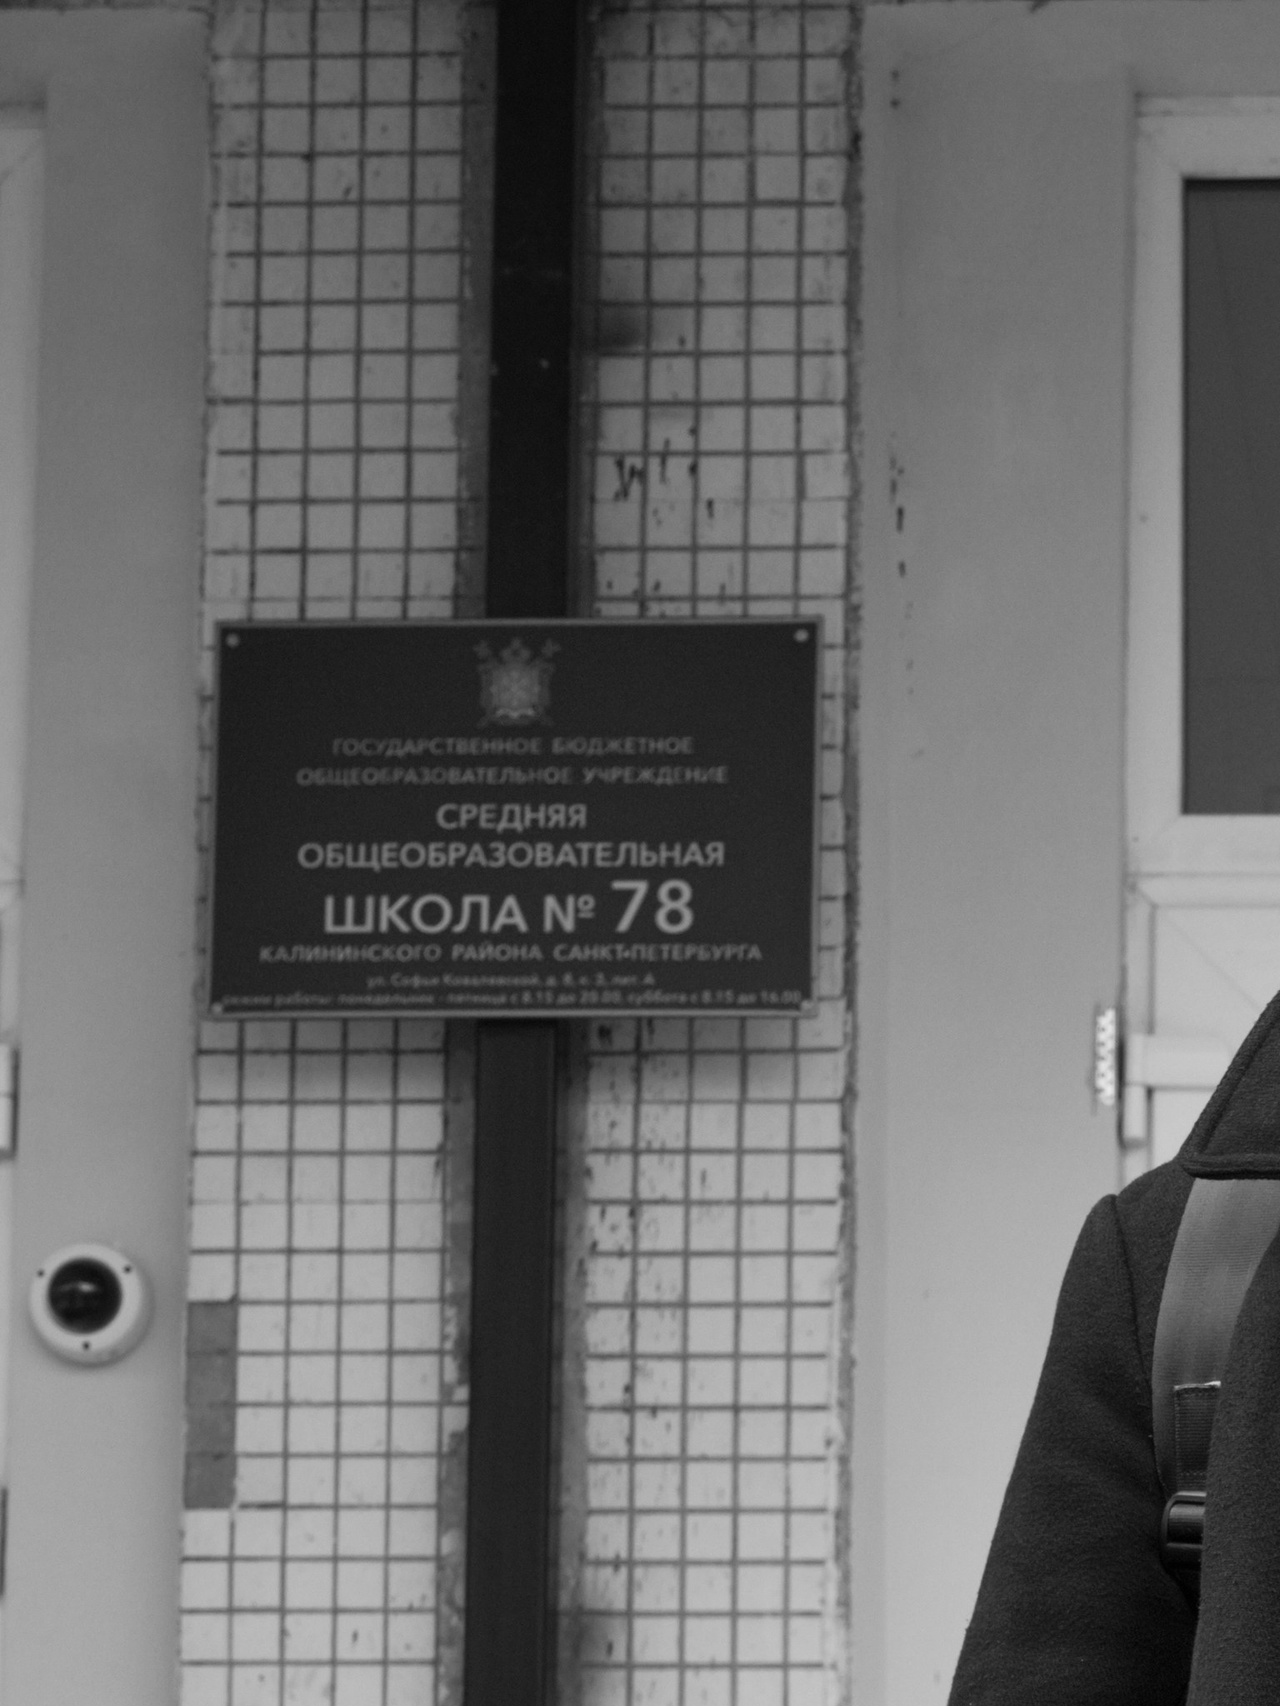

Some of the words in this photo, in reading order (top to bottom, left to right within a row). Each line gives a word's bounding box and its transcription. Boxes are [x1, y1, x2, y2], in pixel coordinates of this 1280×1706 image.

[332, 737, 542, 758] ГОСУДАРСТВЕННОЕ
[551, 736, 694, 757] БЮДЖЕТНОЕ
[296, 765, 573, 788] ОБЩЕОБРАЗОВАТЕЛЬНОЕ
[583, 765, 728, 787] УЧРЕЖДЕНИЕ
[435, 803, 588, 834] СРЕДНЯЯ
[297, 841, 726, 872] ОБЩЕОБРАЗОВАТЕЛЬНАЯ
[324, 893, 529, 934] ШКОЛА
[543, 894, 596, 934] №
[611, 879, 694, 934] 78
[259, 943, 443, 964] КАЛИНИНСКОГО
[451, 941, 544, 963] РАЙОНА
[552, 943, 763, 963] САНКТ-ПЕТЕРБУРГА
